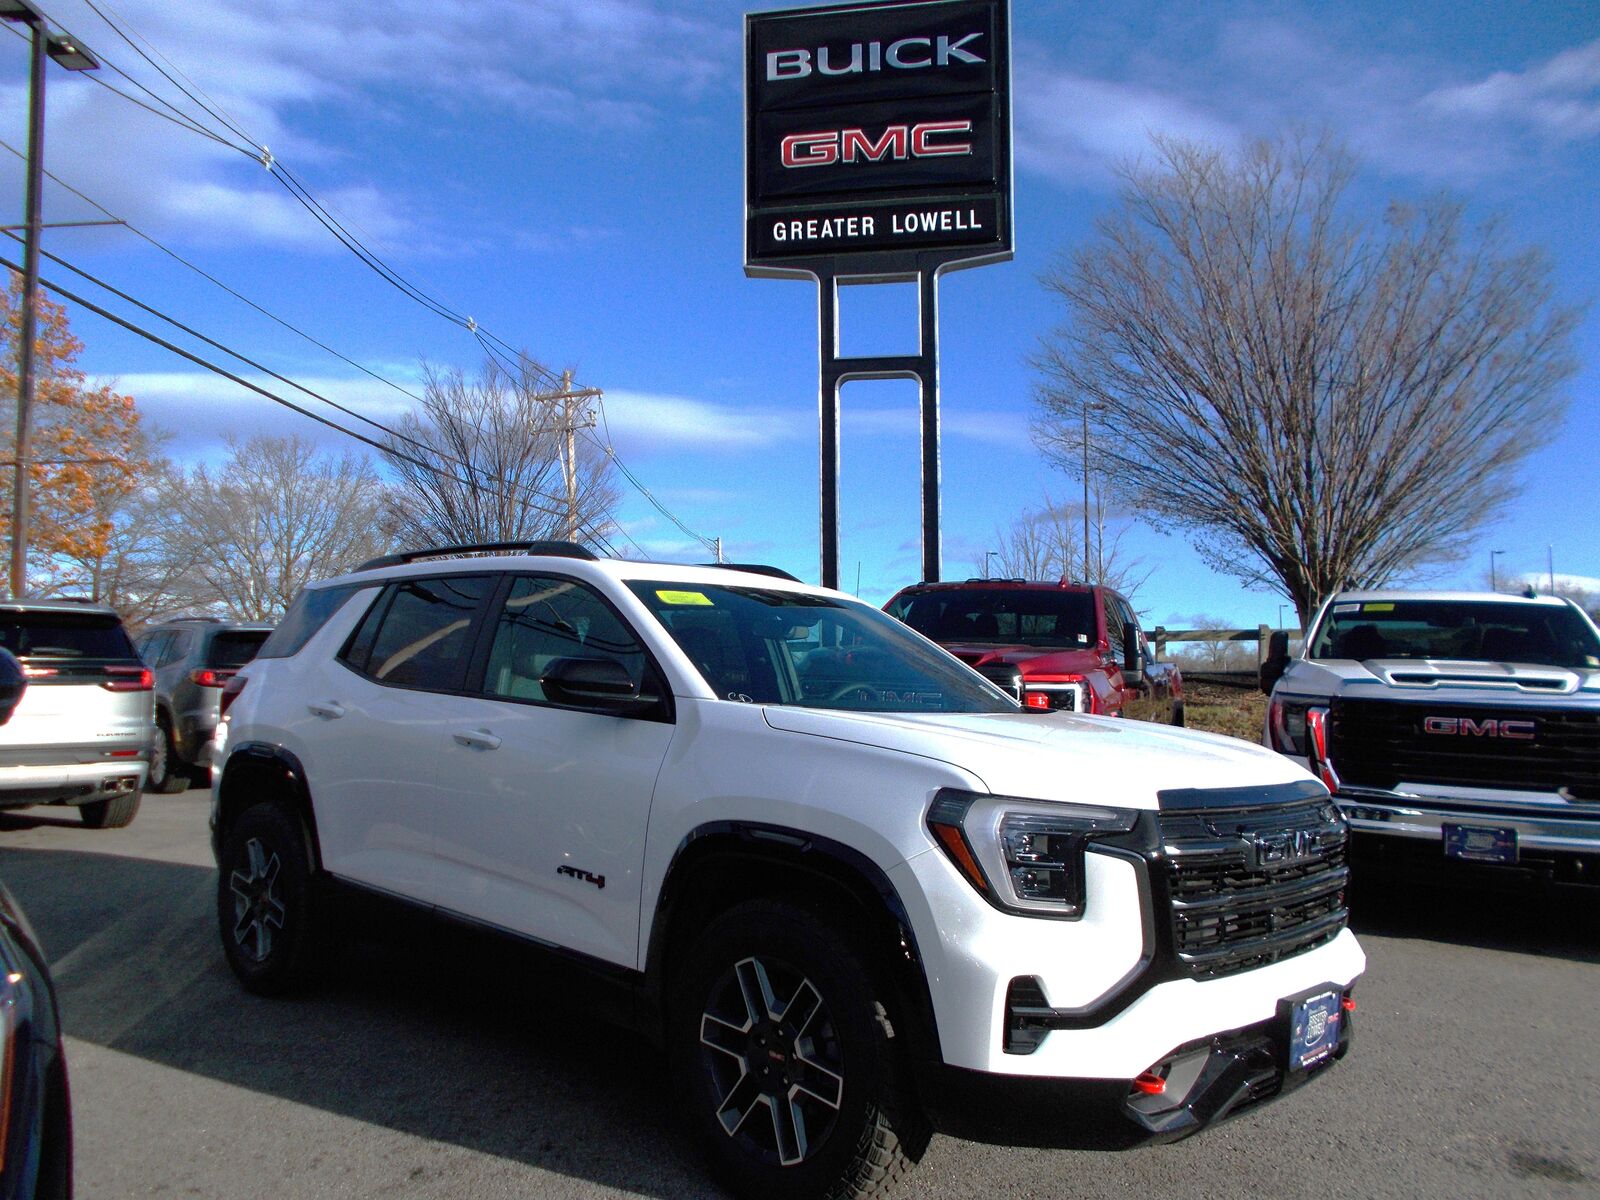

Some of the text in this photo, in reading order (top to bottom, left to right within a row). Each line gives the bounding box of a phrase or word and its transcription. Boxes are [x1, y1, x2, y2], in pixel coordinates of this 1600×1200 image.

[766, 32, 986, 81] BUICK
[781, 120, 972, 168] GMC
[773, 209, 982, 242] GREATER LOWELL
[1425, 716, 1535, 739] GMC
[557, 865, 606, 889] AT4
